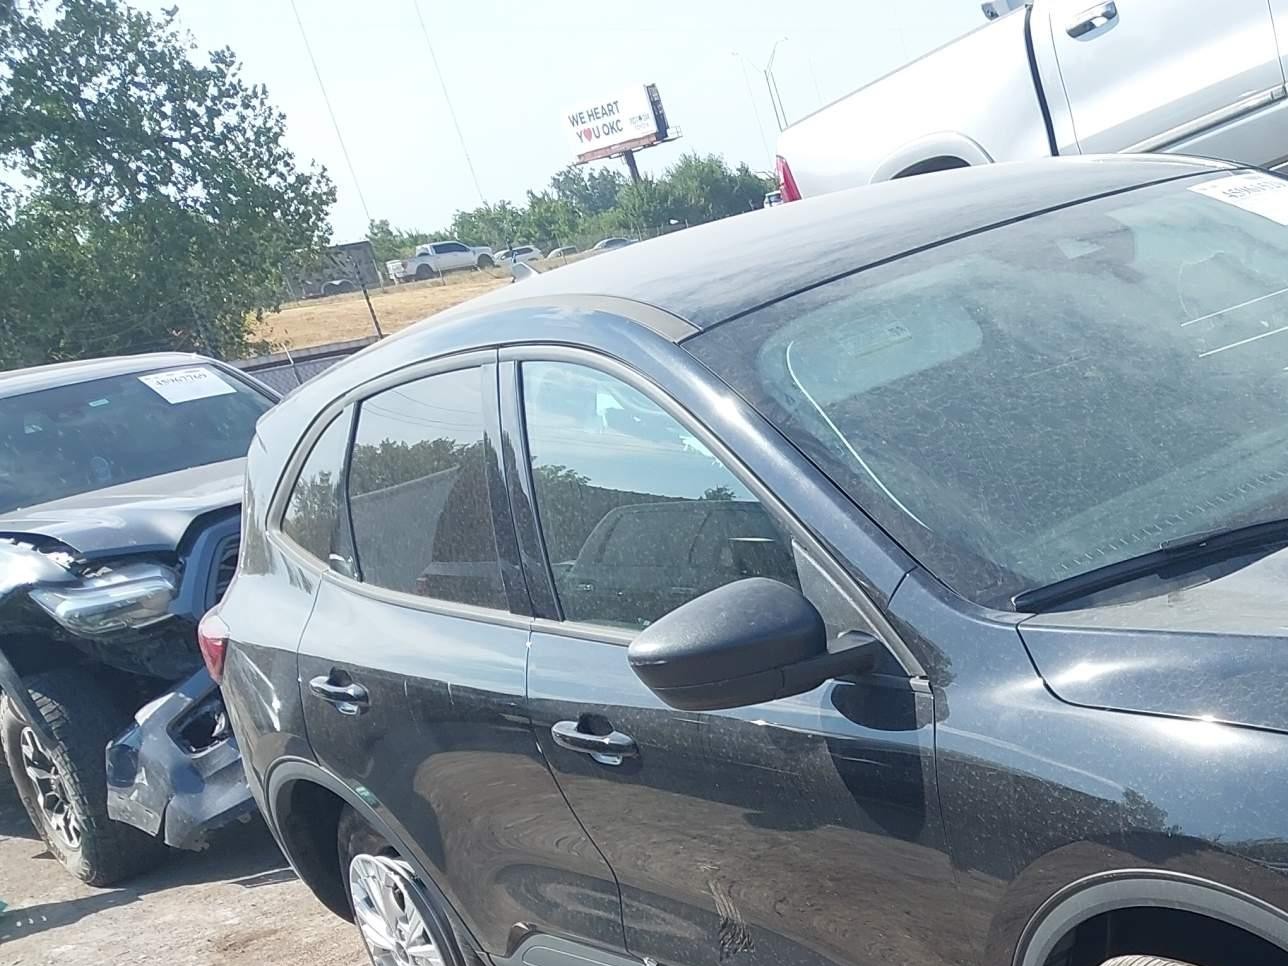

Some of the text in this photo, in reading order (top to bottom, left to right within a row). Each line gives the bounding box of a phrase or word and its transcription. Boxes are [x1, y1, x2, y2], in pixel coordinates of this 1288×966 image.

[568, 112, 586, 127] WE
[586, 100, 620, 121] HEART
[602, 119, 623, 136] OKC
